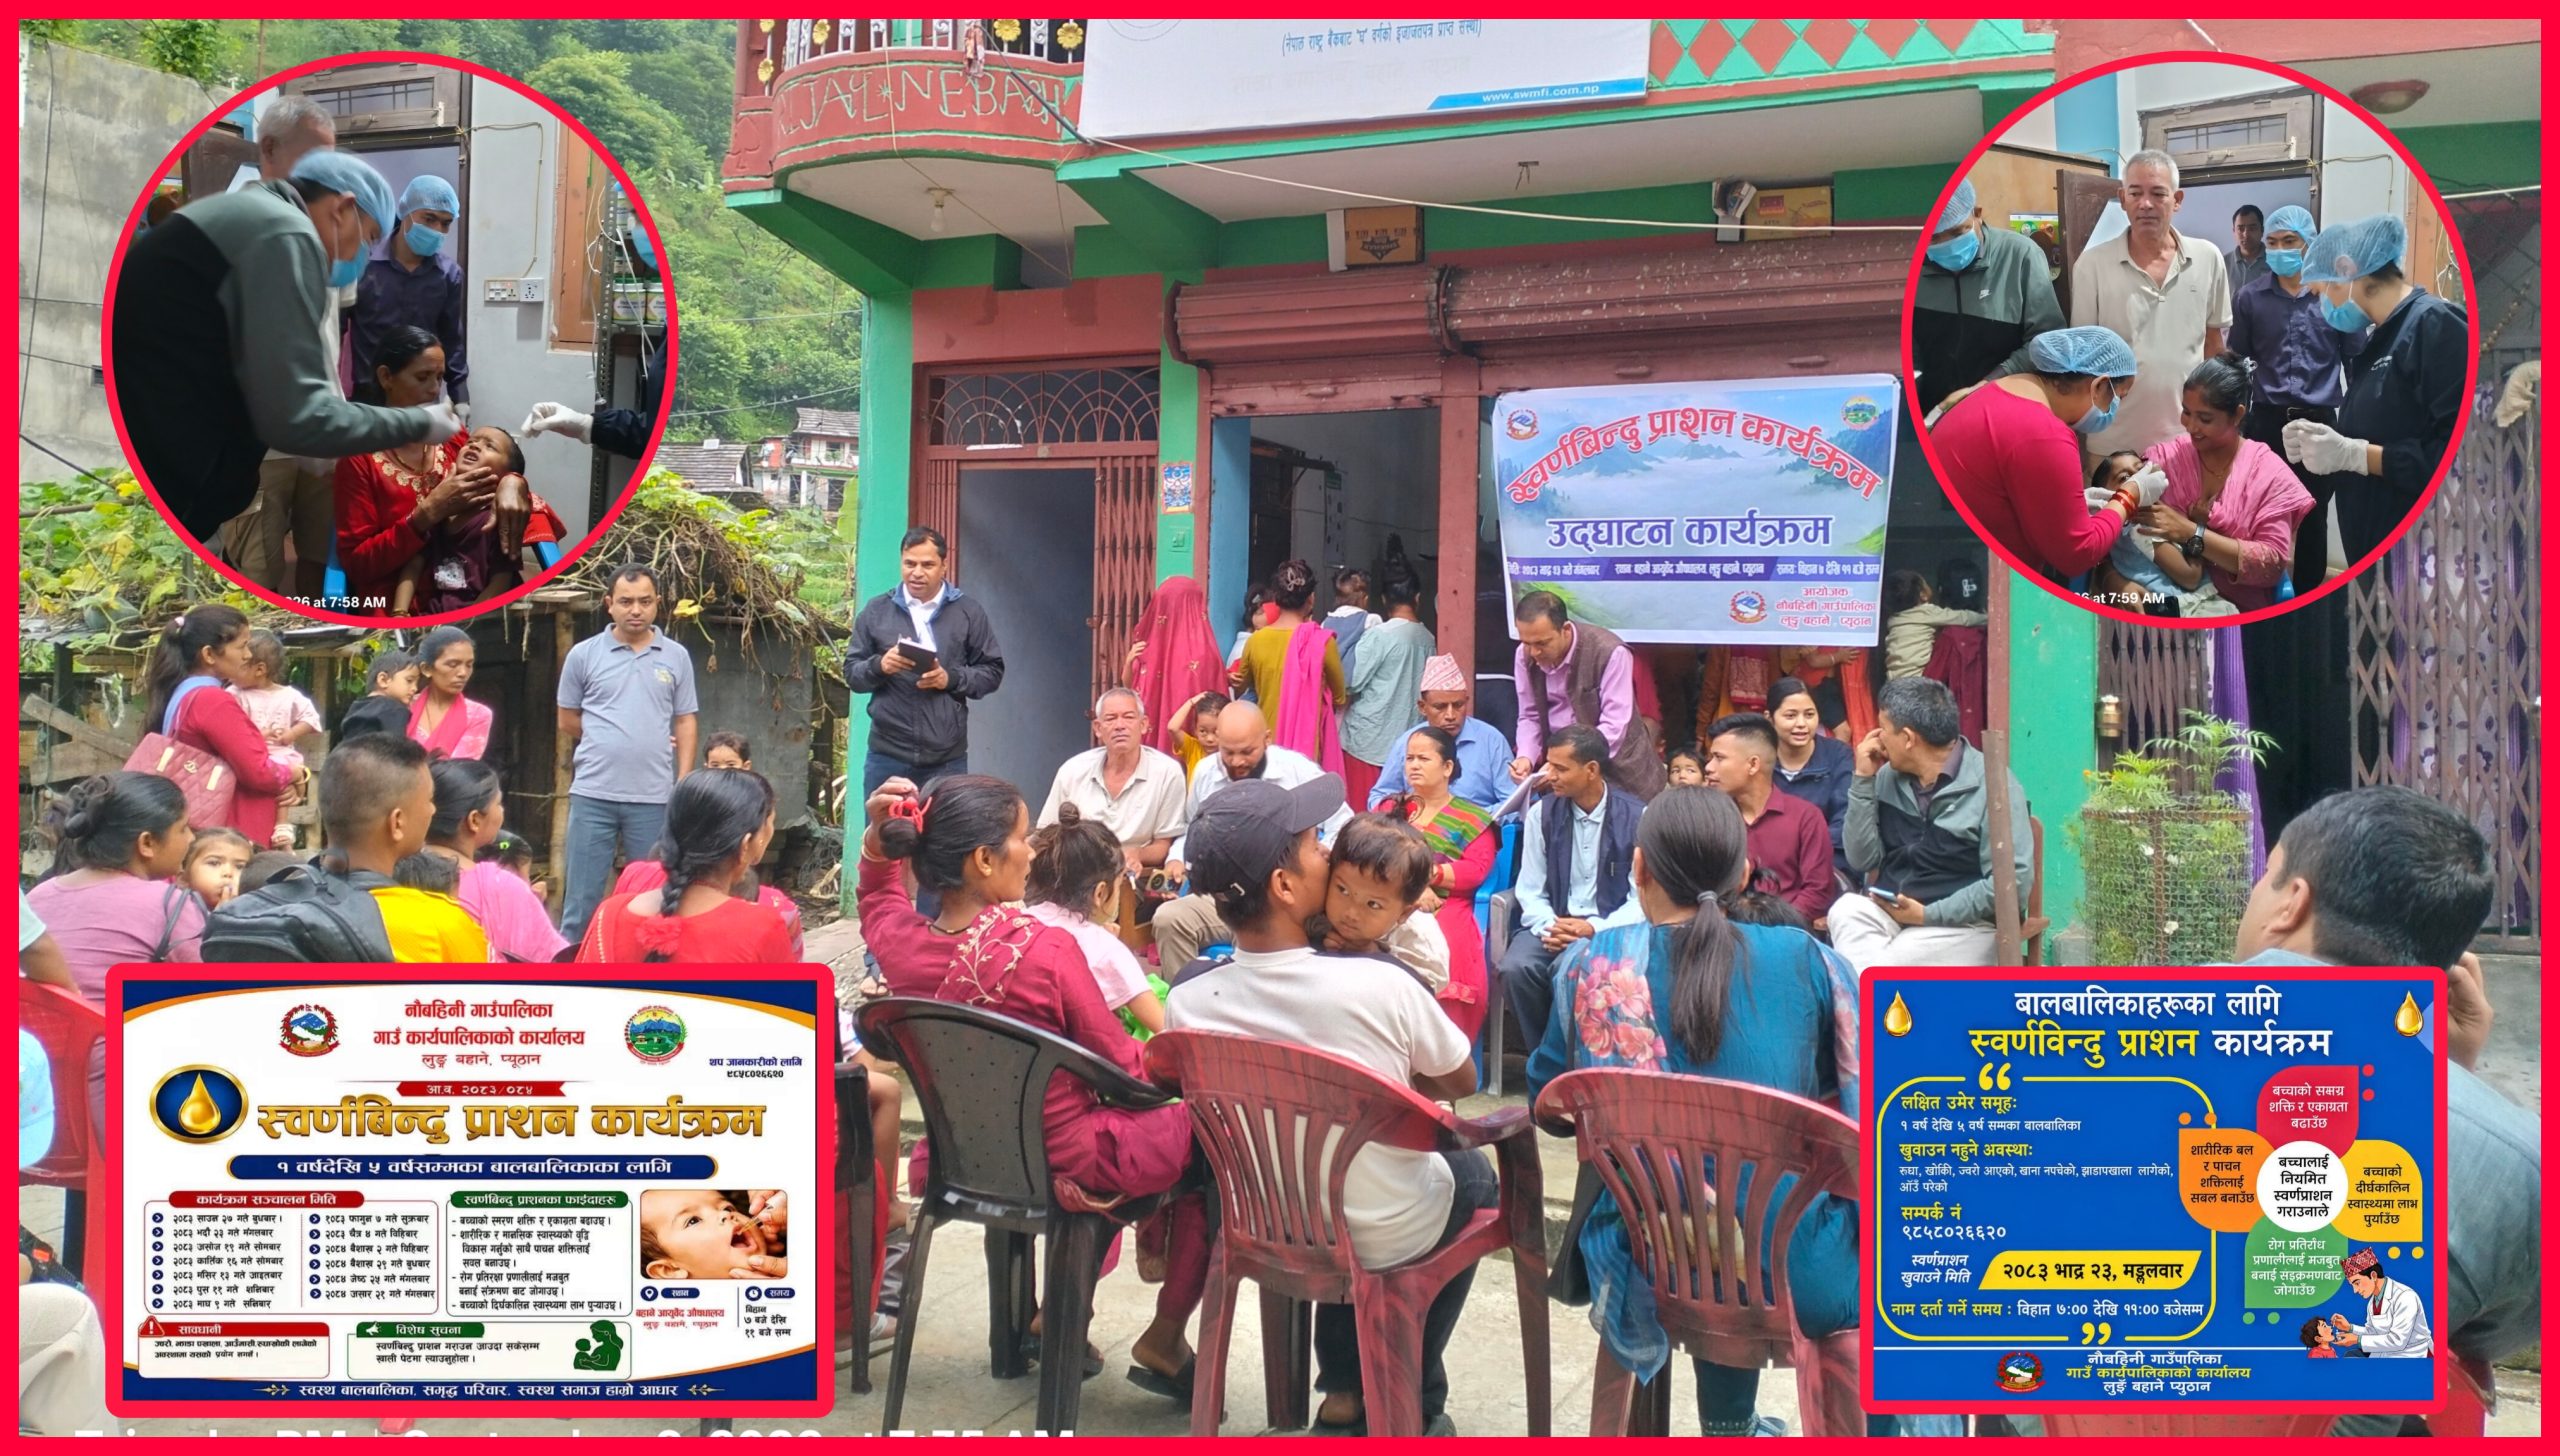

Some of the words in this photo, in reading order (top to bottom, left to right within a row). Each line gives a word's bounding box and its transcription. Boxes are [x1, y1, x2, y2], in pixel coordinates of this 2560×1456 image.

[1481, 83, 1600, 103] www.swmfi.com.np
[1506, 415, 1643, 504] स्वर्णबिन्दु
[1648, 407, 1737, 445] प्राशन
[1741, 411, 1883, 500] कार्यक्रम
[1685, 508, 1834, 549] कार्यक्रम
[2015, 985, 2216, 1018] बालबालिकाहरूका
[2226, 985, 2282, 1015] लागि
[405, 999, 466, 1019] नौबहिनी
[471, 1000, 553, 1018] गाउँपालिका
[374, 1027, 401, 1044] गाउँ
[406, 1026, 514, 1045] कार्यपालिकाको
[520, 1028, 585, 1045] कार्यालय
[1968, 1021, 2105, 1069] स्वर्णविन्दु
[2118, 1030, 2199, 1056] प्राशन
[2212, 1019, 2333, 1057] कार्यक्रम
[2273, 1082, 2312, 1096] बच्चाको
[2270, 1099, 2295, 1112] शक्ति
[2298, 1102, 2304, 1112] र
[2308, 1102, 2348, 1112] एकाग्रता
[257, 1094, 449, 1144] स्वर्णबिन्दु
[461, 1101, 579, 1140] प्राशन
[591, 1095, 767, 1139] कार्यक्रम
[1901, 1121, 1906, 1130] १
[1912, 1119, 1928, 1130] वर्ष
[1932, 1119, 1953, 1132] देखि
[1958, 1121, 1964, 1132] ५
[1968, 1119, 1984, 1130] वर्ष
[1988, 1121, 2020, 1130] सम्मका
[2024, 1119, 2081, 1130] बालबालिका
[2191, 1143, 2232, 1155] शारीरिक
[2236, 1146, 2254, 1155] बल
[278, 1162, 288, 1172] १
[297, 1158, 361, 1174] वर्षदेखि
[369, 1162, 380, 1174] ५
[388, 1159, 483, 1173] वर्षसम्मका
[491, 1158, 619, 1173] बालबालिकाका
[627, 1158, 672, 1173] लागि
[2204, 1162, 2209, 1171] र
[2213, 1162, 2241, 1171] पाचन
[2278, 1154, 2329, 1169] बच्चालाई
[2280, 1171, 2327, 1184] नियमित
[2363, 1165, 2402, 1178] बच्चाको
[2201, 1175, 2244, 1189] शक्तिलाई
[2274, 1187, 2333, 1201] स्वर्णप्राशन
[1901, 1202, 1944, 1220] सम्पर्क
[1950, 1204, 1962, 1220] नं
[2277, 1204, 2329, 1217] गराउनाले
[2349, 1200, 2394, 1208] स्वास्थ्यमा
[2397, 1200, 2418, 1208] लाभ
[1903, 1226, 2006, 1240] ९८५८०२६६२०
[2268, 1238, 2285, 1250] रोग
[1912, 1252, 1969, 1266] स्वर्णप्राशन
[1901, 1269, 1942, 1288] खुवाउने
[1945, 1269, 1972, 1282] मिति
[2004, 1264, 2048, 1281] २०८३
[2055, 1264, 2085, 1279] भाद्र
[2092, 1264, 2116, 1281] २३,
[2087, 1350, 2145, 1366] नौबहिनी
[2150, 1350, 2223, 1365] गाउँपालिका
[2066, 1366, 2092, 1378] गाउँ
[2097, 1366, 2192, 1378] कार्यपालिकाको
[2196, 1366, 2251, 1378] कार्यालय
